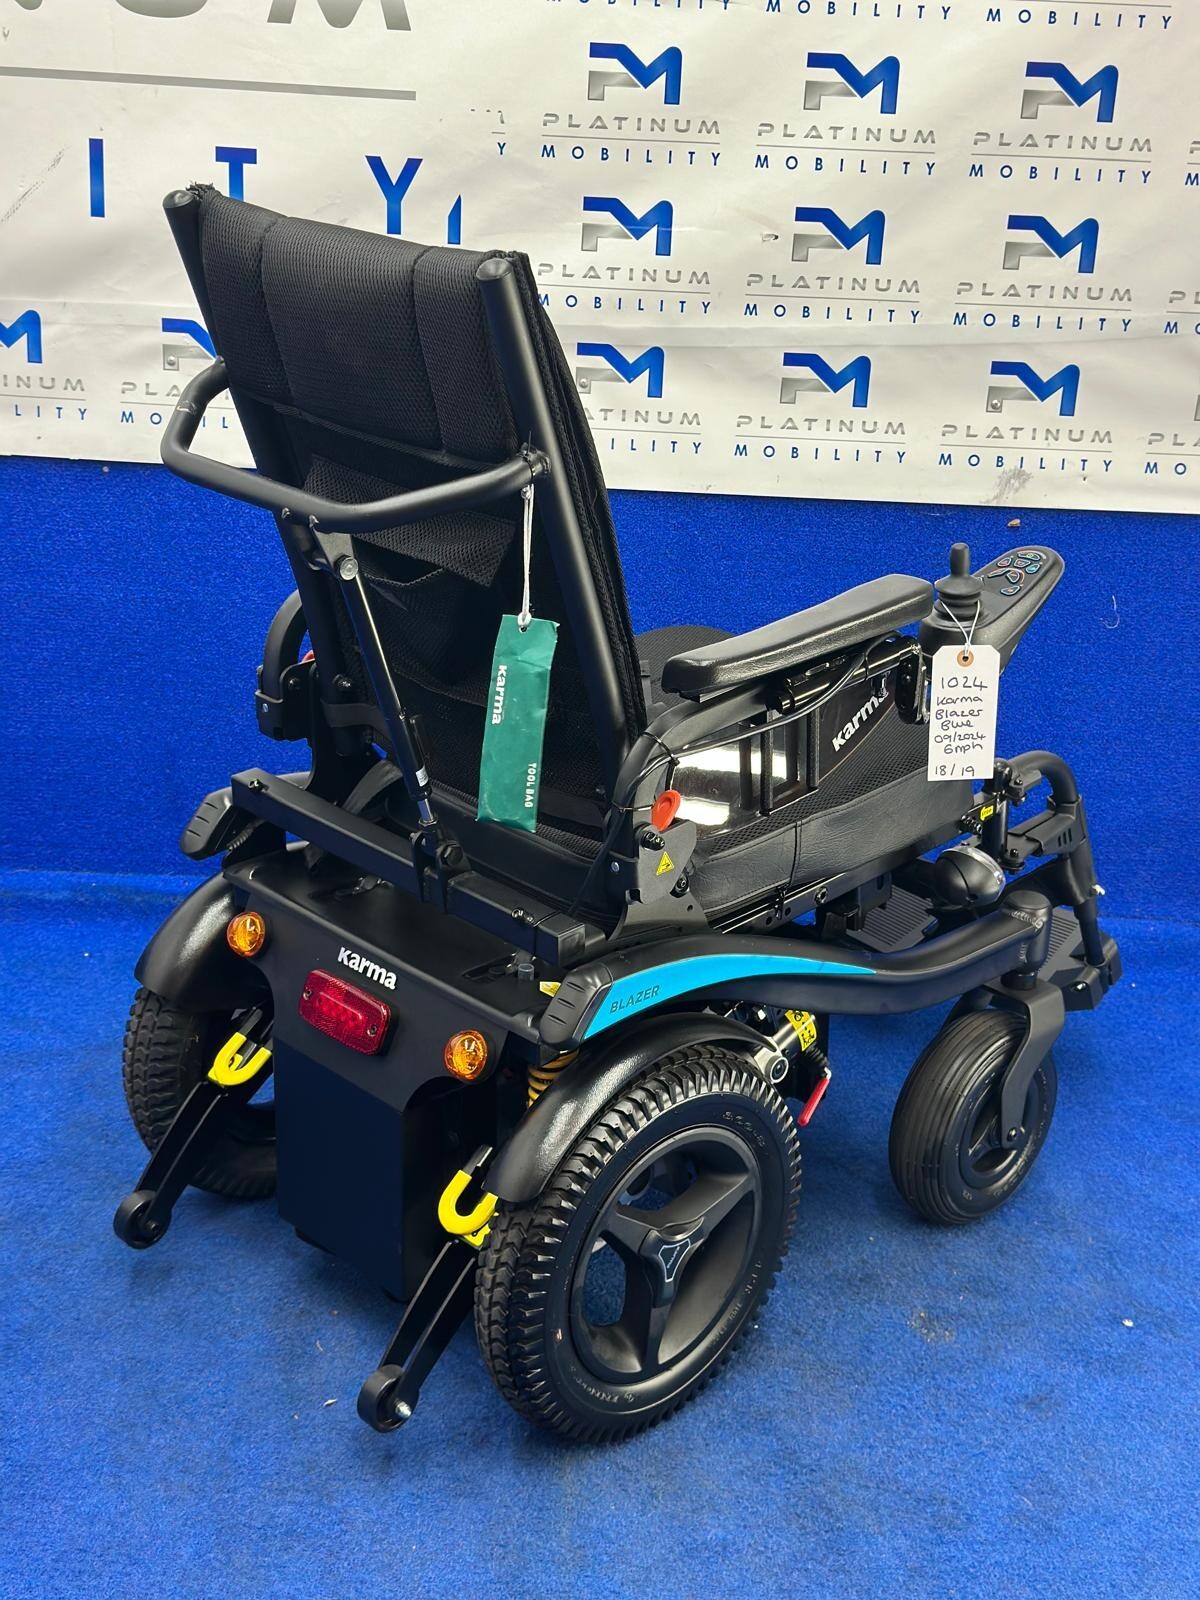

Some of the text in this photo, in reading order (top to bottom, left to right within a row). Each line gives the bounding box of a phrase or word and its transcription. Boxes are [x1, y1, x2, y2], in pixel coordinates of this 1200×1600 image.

[766, 0, 951, 20] MOBILITY
[986, 8, 1172, 29] MOBILITY
[542, 113, 720, 135] PLATINUM
[757, 123, 936, 144] PLATINUM
[973, 132, 1151, 152] PLATINUM
[541, 144, 720, 167] MOBILITY
[755, 155, 936, 175] MOBILITY
[969, 164, 1151, 184] MOBILITY
[537, 263, 711, 285] PLATINUM
[746, 274, 920, 293] PLATINUM
[956, 282, 1132, 302] PLATINUM
[744, 303, 920, 323] MOBILITY
[953, 312, 1131, 332] MOBILITY
[736, 415, 906, 434] PLATINUM
[941, 424, 1112, 444] PLATINUM
[734, 444, 906, 463] MOBILITY
[938, 453, 1112, 472] MOBILITY
[941, 676, 988, 691] 1024
[491, 665, 507, 725] karma
[934, 731, 986, 744] 09/2024
[526, 763, 536, 787] TOOL
[609, 984, 660, 1014] BLAZER
